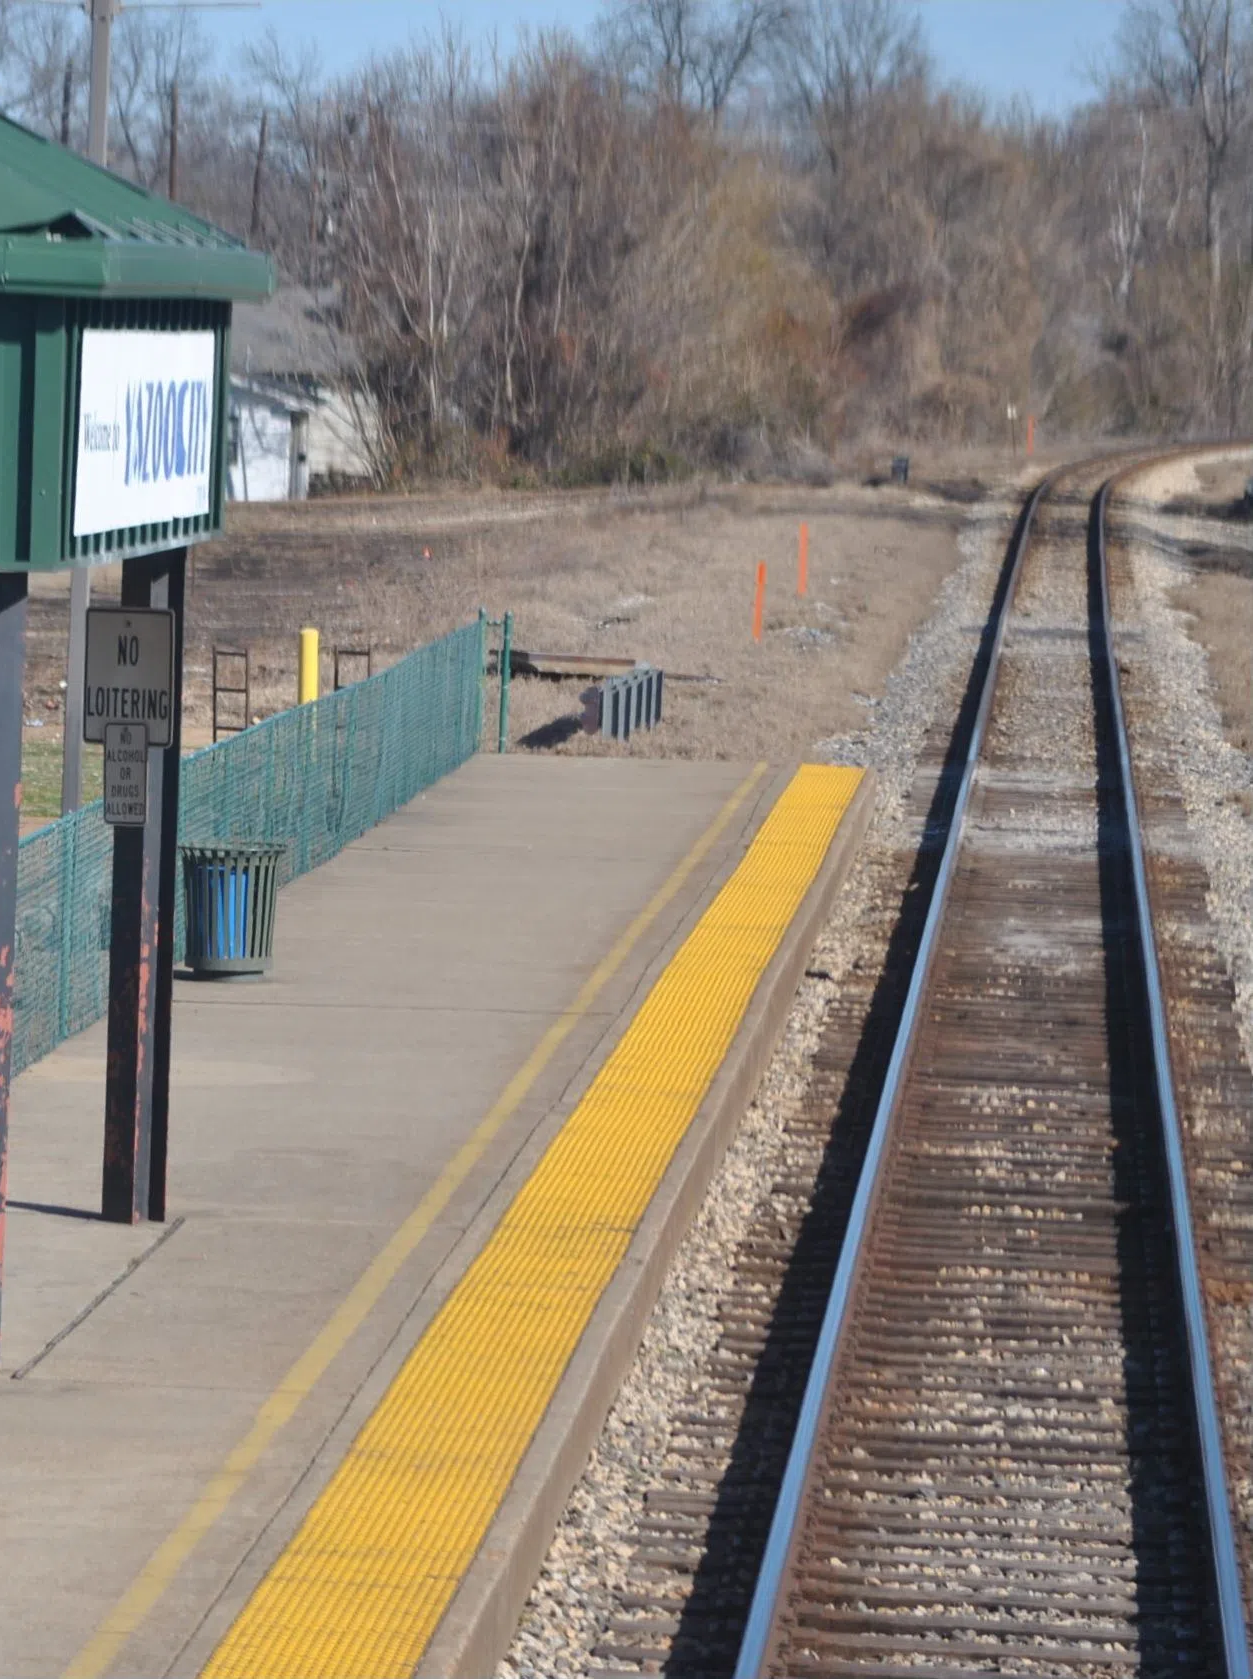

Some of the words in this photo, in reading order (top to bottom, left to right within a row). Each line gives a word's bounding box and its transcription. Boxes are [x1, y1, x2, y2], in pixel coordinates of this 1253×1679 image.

[84, 411, 111, 452] Welcome
[117, 635, 139, 666] NO
[87, 686, 168, 720] LOITERING
[120, 732, 132, 745] NO
[107, 749, 145, 763] ALCOHOL
[119, 767, 131, 780] OR
[111, 784, 139, 798] DRUGS
[106, 802, 145, 816] ALLOWED
